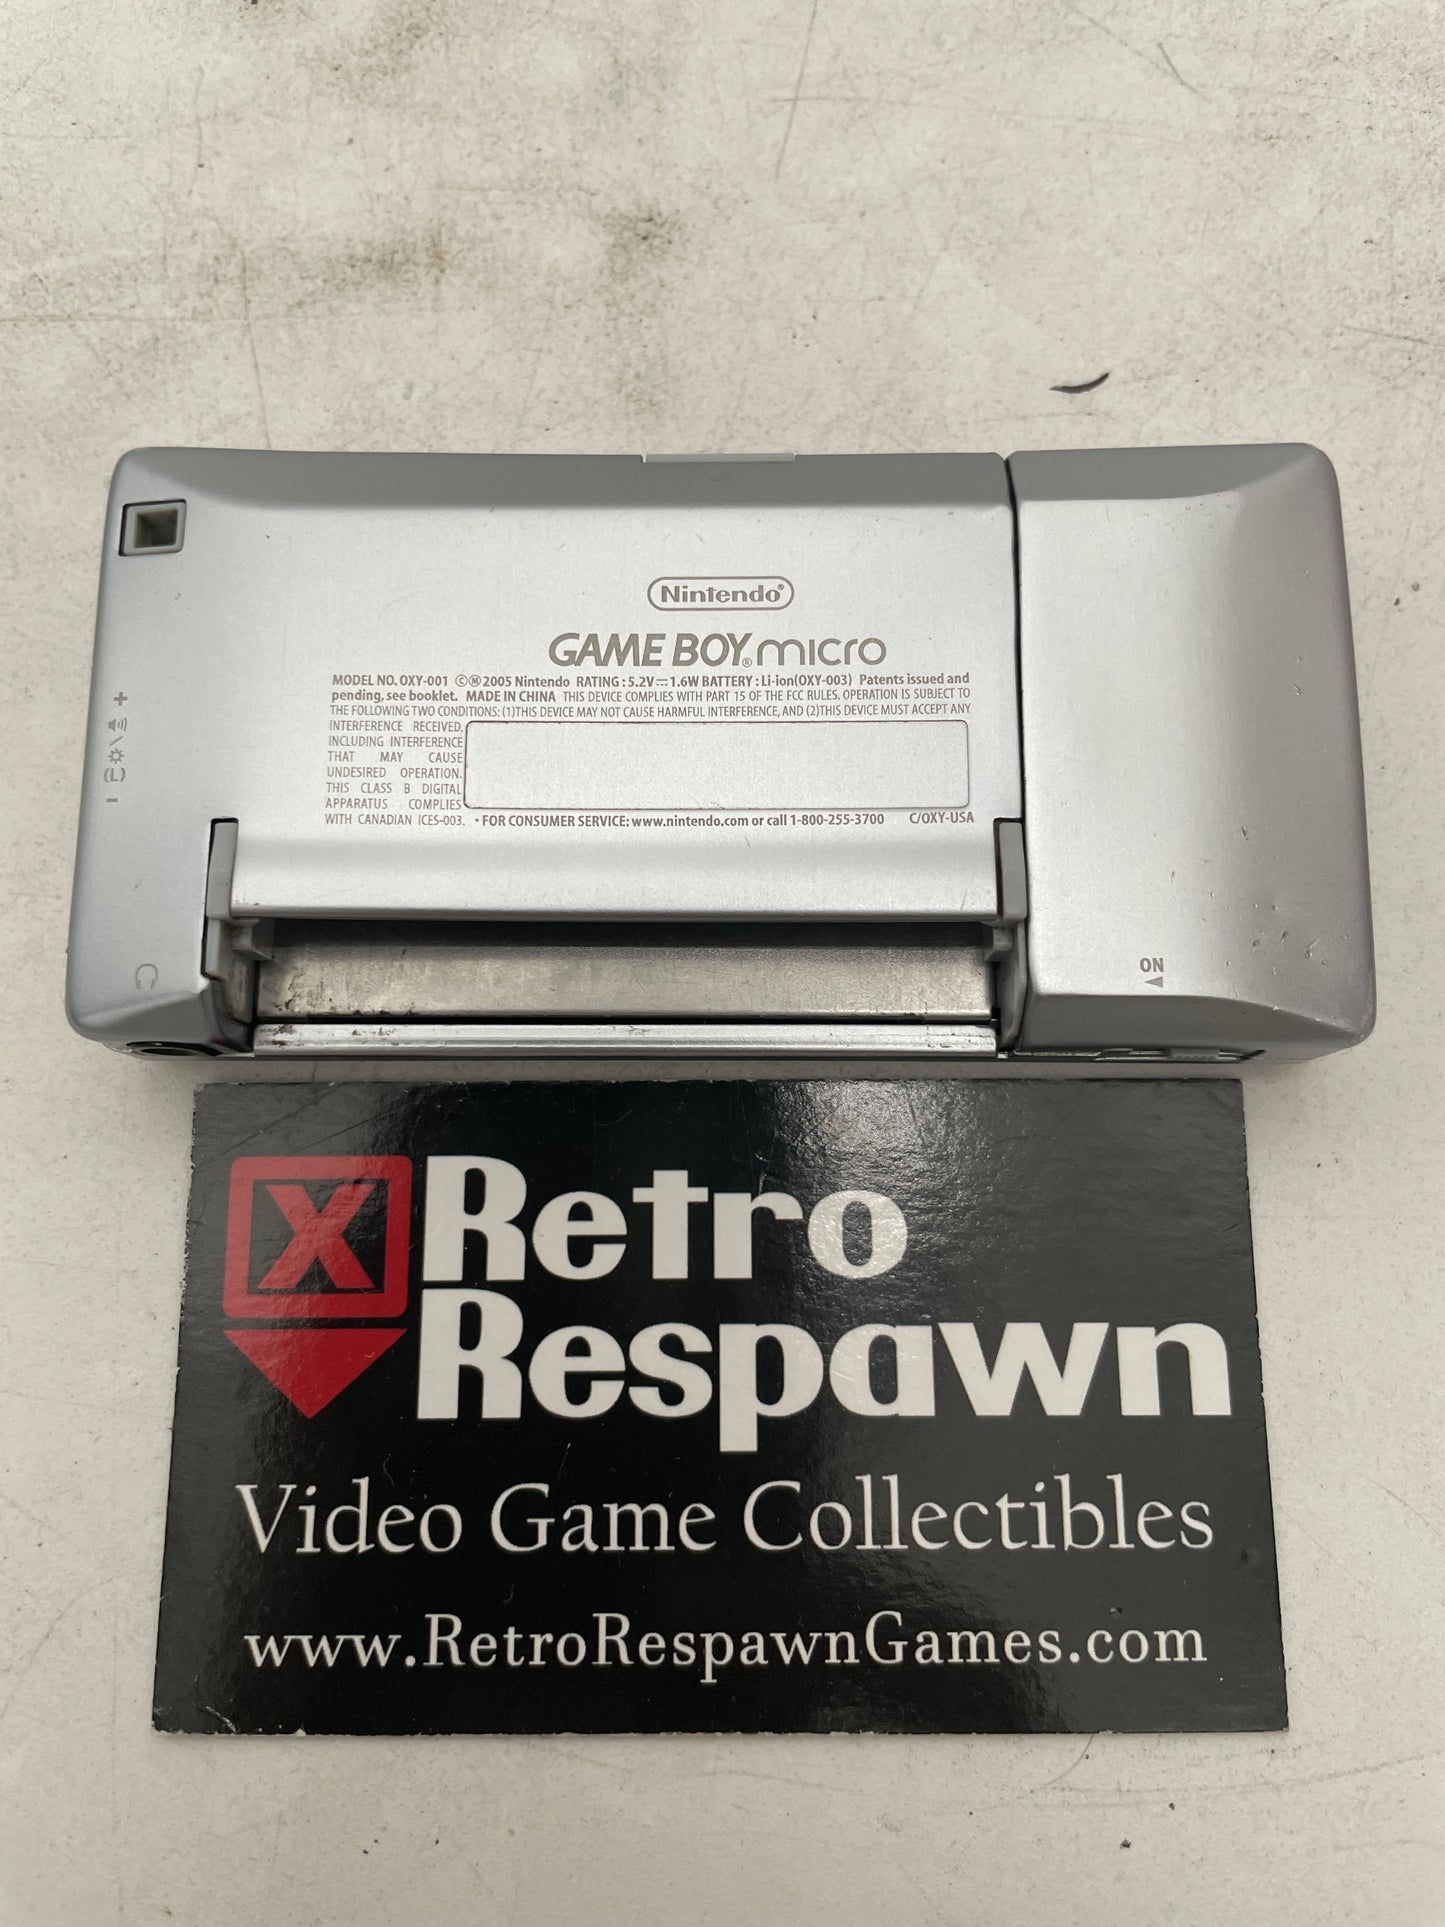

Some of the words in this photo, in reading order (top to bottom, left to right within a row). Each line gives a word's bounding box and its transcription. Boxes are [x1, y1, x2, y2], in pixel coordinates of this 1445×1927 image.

[548, 631, 667, 667] GAME
[757, 638, 887, 666] micro
[332, 675, 375, 686] MODEL
[377, 675, 398, 686] NO.
[400, 675, 448, 686] OXY-001
[515, 676, 570, 687] Nintendo
[577, 676, 619, 687] RATING
[702, 676, 752, 687] BATTERY
[860, 674, 904, 685] Patents
[907, 673, 944, 685] issued
[947, 672, 969, 684] and
[332, 690, 385, 703] pending,
[387, 692, 406, 701] see
[409, 690, 458, 702] booklet.
[466, 691, 501, 702] MADE
[504, 691, 516, 702] IN
[519, 691, 555, 702] CHINA
[564, 691, 584, 702] THIS
[589, 691, 622, 702] DEVICE
[625, 691, 674, 702] COMPLIES
[677, 691, 703, 701] WITH
[706, 691, 730, 701] PART
[734, 691, 746, 701] 15
[749, 690, 761, 701] OF
[765, 690, 783, 701] THE
[787, 690, 804, 701] FCC
[807, 690, 840, 701] RULES.
[843, 689, 898, 700] OPERATION
[901, 689, 910, 699] IS
[914, 688, 955, 699] SUBJECT
[957, 688, 970, 698] TO
[330, 705, 349, 716] THE
[351, 706, 410, 716] FOLLOWING
[412, 706, 435, 716] TWO
[438, 706, 500, 717] CONDITIONS:
[540, 707, 573, 717] DEVICE
[577, 707, 597, 717] MAY
[601, 707, 621, 717] NOT
[624, 707, 654, 717] CAUSE
[658, 707, 705, 717] HARMFUL
[708, 706, 780, 717] INTERFERENCE,
[783, 706, 803, 717] AND
[844, 705, 878, 716] DEVICE
[881, 704, 909, 715] MUST
[912, 704, 948, 714] ACCEPT
[950, 703, 971, 714] ANY
[330, 720, 403, 731] INTERFERENCE
[329, 736, 384, 747] INCLUDING
[390, 737, 463, 748] INTERFERENCE
[328, 752, 354, 762] THAT
[380, 752, 403, 762] MAY
[428, 752, 463, 763] CAUSE
[327, 767, 386, 778] UNDESIRED
[400, 767, 462, 778] OPERATION.
[327, 782, 349, 793] THIS
[360, 783, 392, 793] CLASS
[405, 783, 410, 794] B
[422, 783, 462, 794] DIGITAL
[325, 798, 388, 809] APPARATUS
[409, 799, 461, 810] COMPLIES
[325, 814, 352, 825] WITH
[358, 814, 412, 825] CANADIAN
[418, 814, 465, 826] ICES-003.
[483, 815, 505, 826] FOR
[509, 815, 575, 826] CONSUMER
[578, 816, 629, 827] SERVICE:
[632, 815, 749, 826] www.nintendo.com
[752, 817, 764, 826] or
[767, 814, 787, 826] call
[790, 813, 884, 825] 1-800-255-3700
[909, 812, 974, 824] C/OXY-USA
[1140, 958, 1164, 972] ON
[422, 1154, 909, 1281] Retro
[417, 1288, 1233, 1453] Respawn
[235, 1477, 464, 1556] Video
[491, 1483, 718, 1553] Game
[743, 1473, 1215, 1551] Collectibles
[243, 1610, 1208, 1683] www.RetroRespawnGames.com
